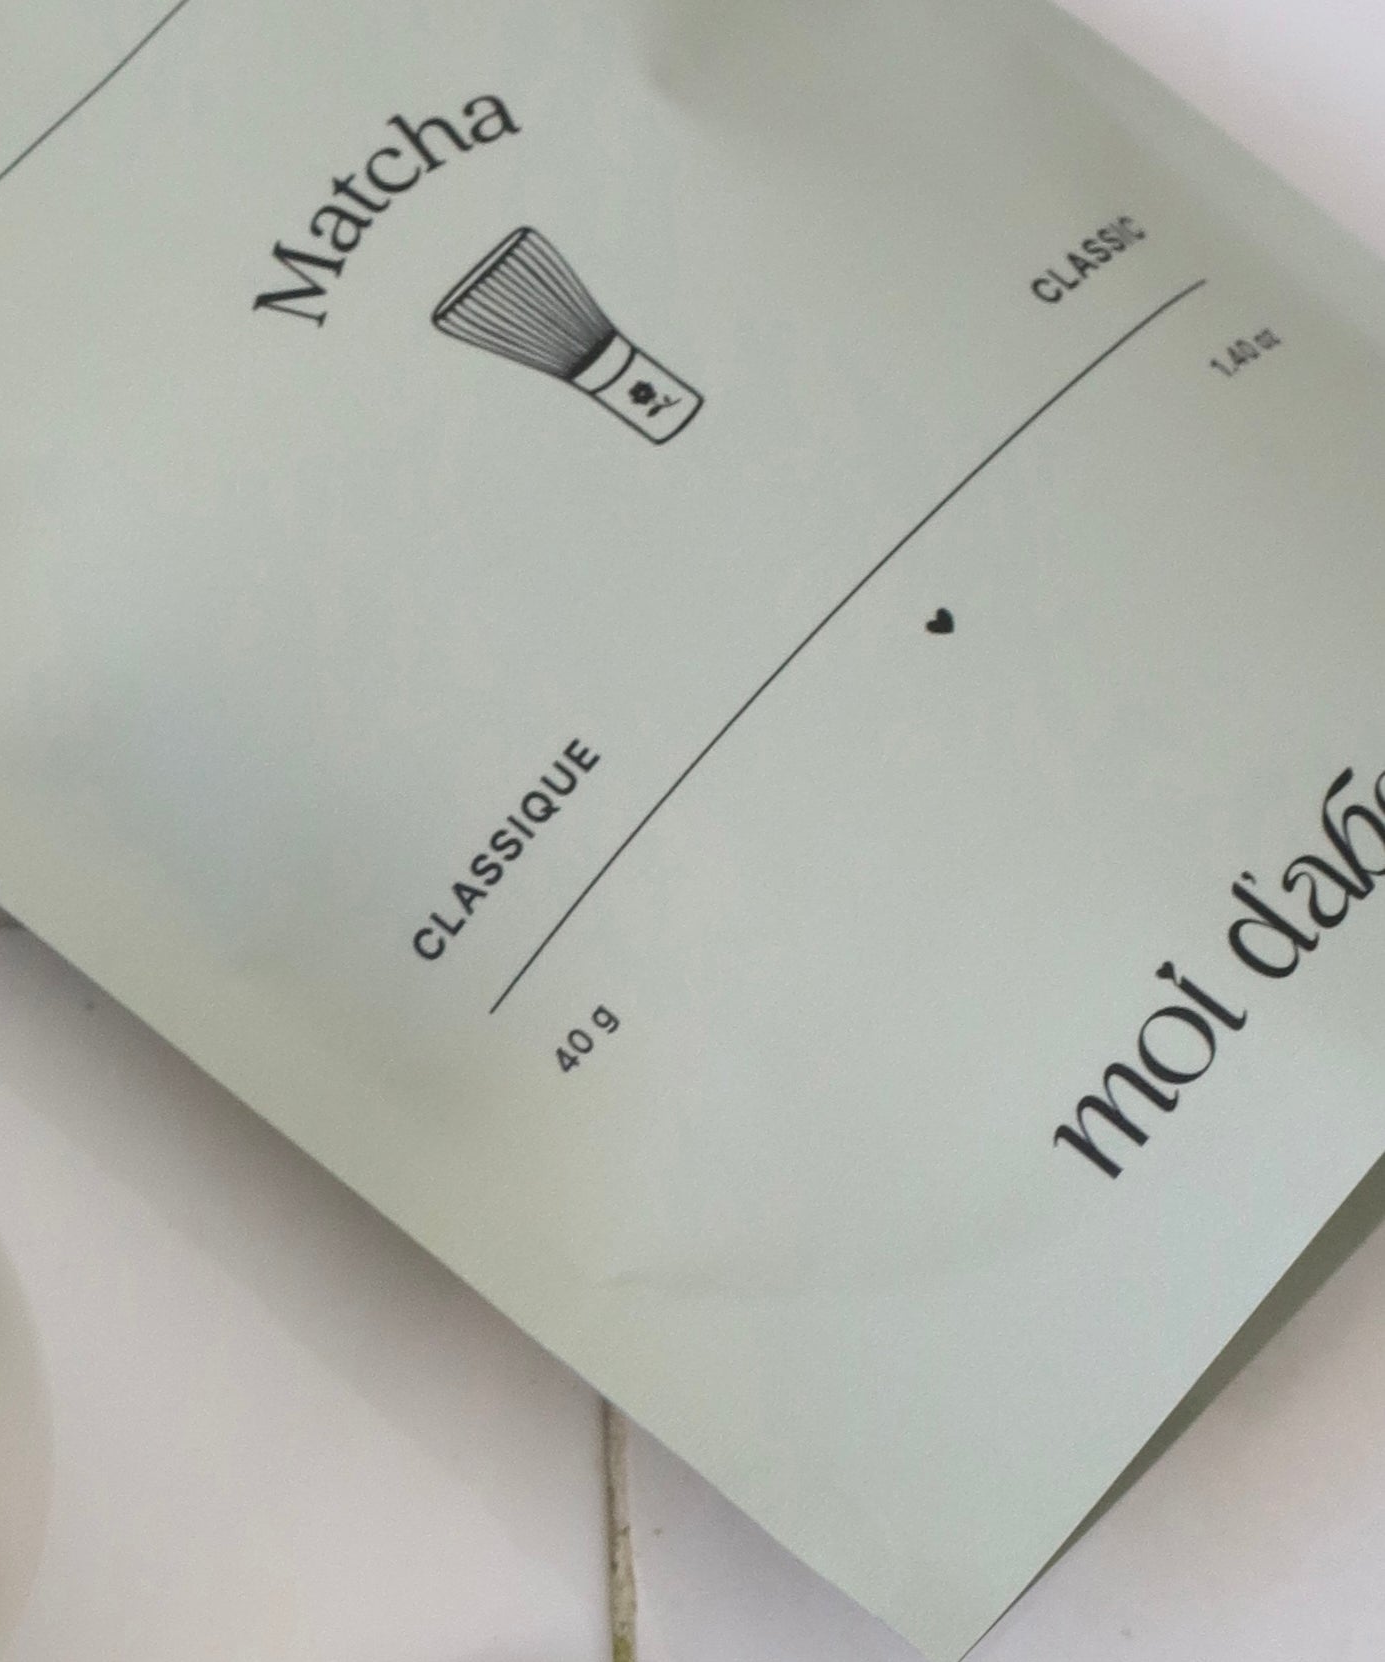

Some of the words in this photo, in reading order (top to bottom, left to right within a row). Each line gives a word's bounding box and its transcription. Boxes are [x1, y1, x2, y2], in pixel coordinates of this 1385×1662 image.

[252, 94, 522, 328] Matcha
[1030, 215, 1147, 304] CLASSIC
[412, 738, 601, 961] CLASSIQUE
[555, 1028, 595, 1074] 40
[591, 1004, 621, 1035] g
[1053, 960, 1248, 1180] moi
[1228, 766, 1385, 979] d'ab
